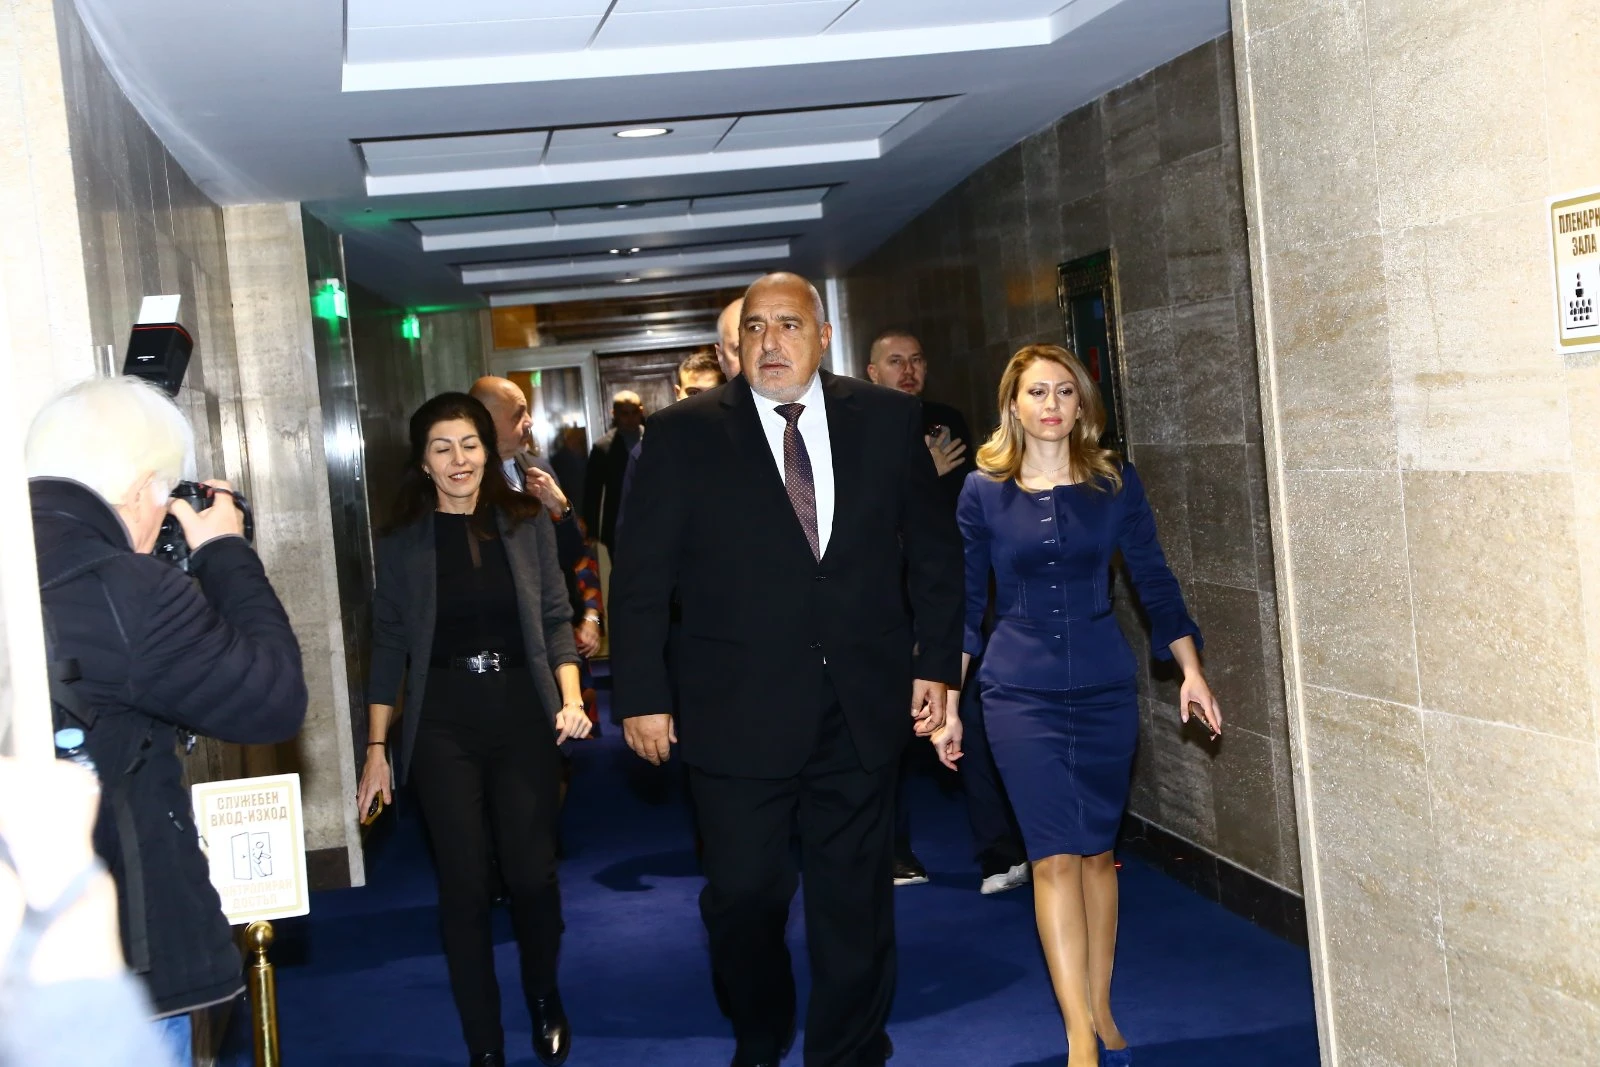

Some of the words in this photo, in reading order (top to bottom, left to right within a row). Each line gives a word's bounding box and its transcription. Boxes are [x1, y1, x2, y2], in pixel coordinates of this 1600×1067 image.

[1571, 233, 1597, 256] ЗАЛА
[217, 791, 279, 810] СЛУЖЕБЕН
[211, 806, 288, 827] ВХОД-ИЗХОД
[220, 879, 292, 898] ОНТРОЛИРАН
